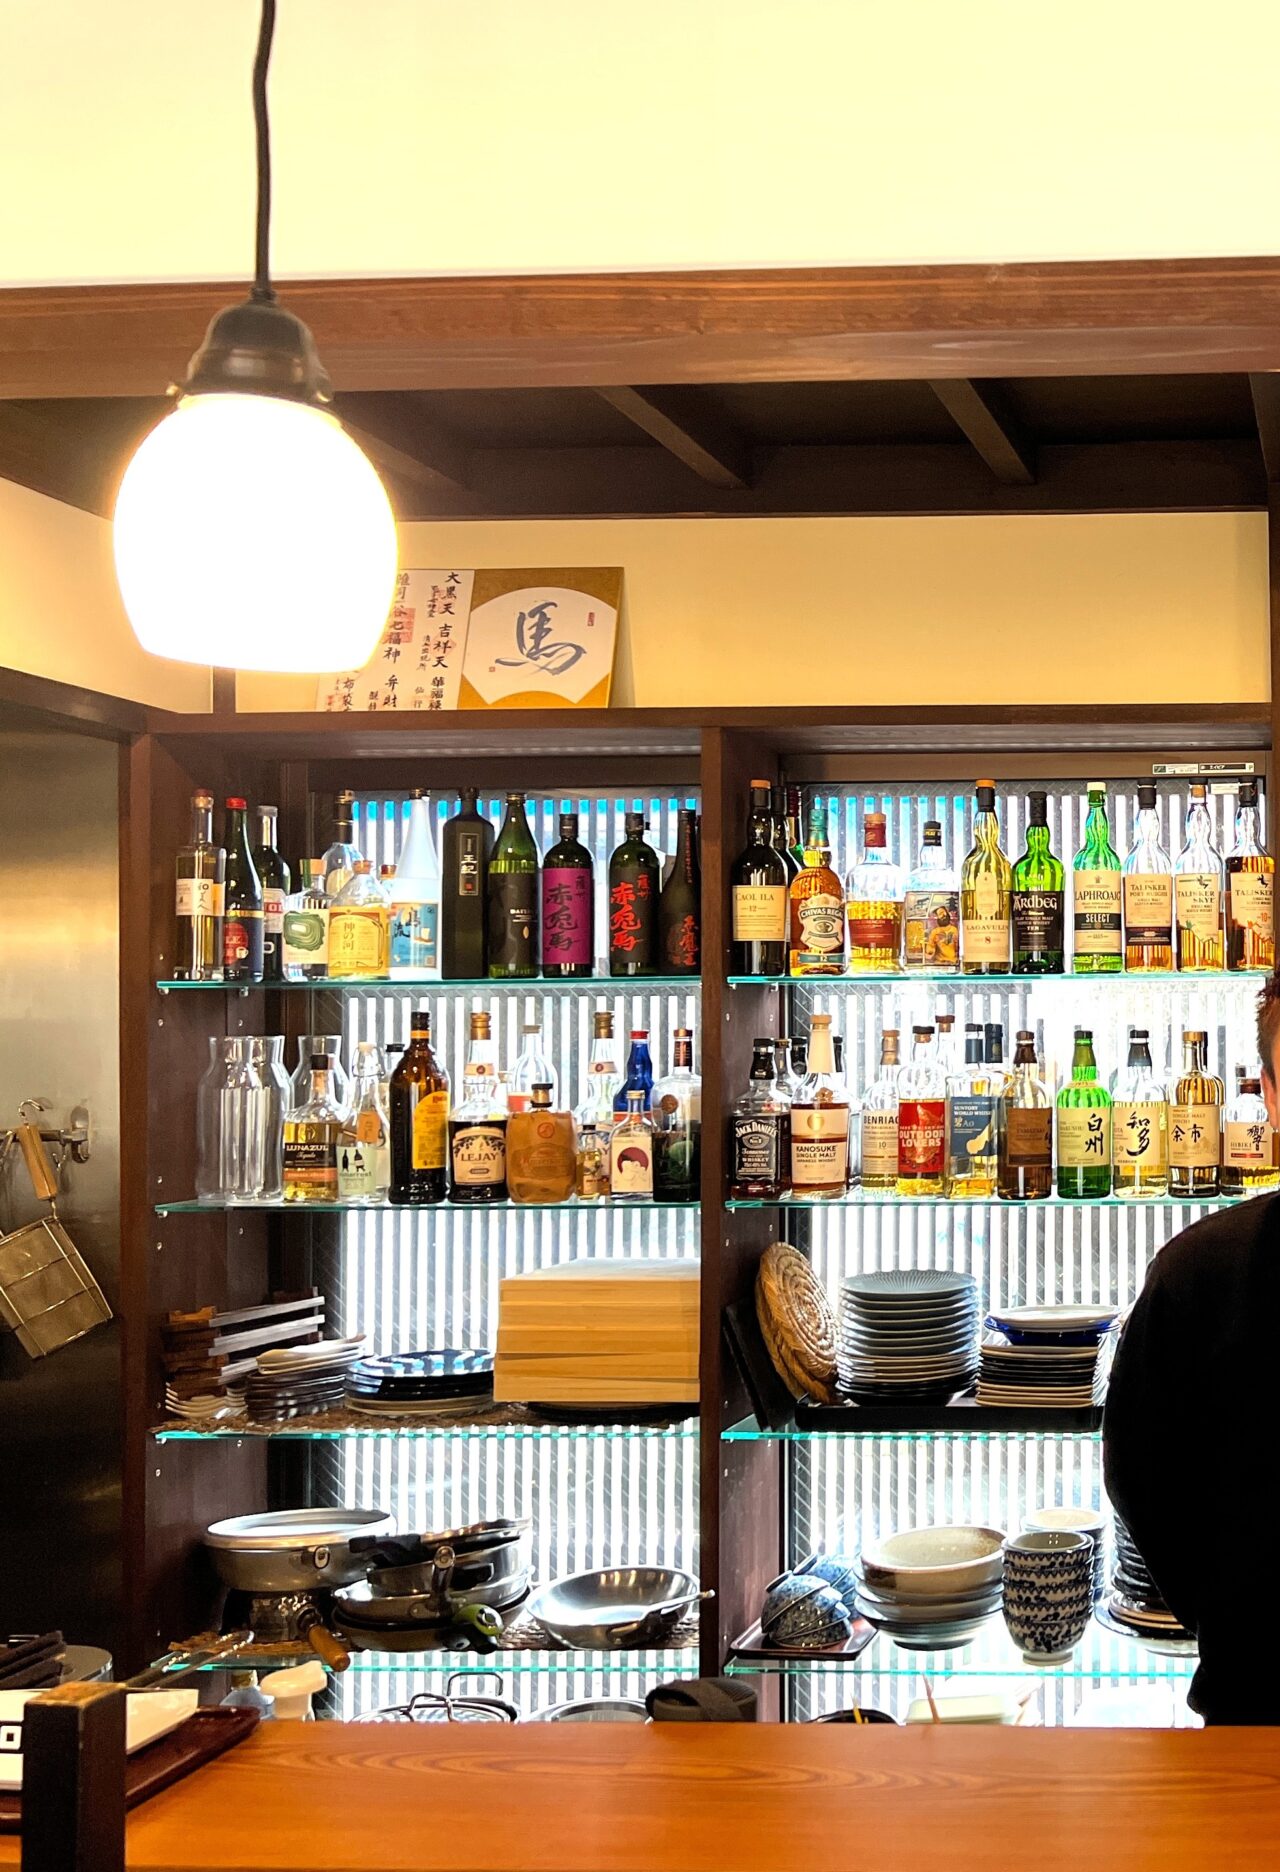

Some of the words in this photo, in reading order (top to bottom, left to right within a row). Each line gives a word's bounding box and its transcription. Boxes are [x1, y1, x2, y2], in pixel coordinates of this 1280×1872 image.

[494, 601, 587, 676] 馬
[735, 893, 756, 901] CAOL
[760, 893, 775, 901] ILA
[544, 883, 582, 953] 赤兎馬
[610, 882, 642, 952] 赤兎馬
[800, 908, 826, 918] CHIVAS
[1085, 913, 1110, 923] SELECT
[1261, 912, 1268, 922] 10
[343, 922, 355, 951] 神の河
[984, 936, 991, 944] 8
[735, 1124, 752, 1138] JACK
[899, 1130, 944, 1139] OUTDOOR
[1085, 1113, 1104, 1156] 白州
[1126, 1111, 1151, 1156] 知多
[1171, 1123, 1204, 1143] 余市
[901, 1138, 942, 1147] LOVERS
[1247, 1125, 1268, 1151] 響
[796, 1145, 837, 1153] KANOSUKE
[461, 1153, 498, 1162] LEJAY
